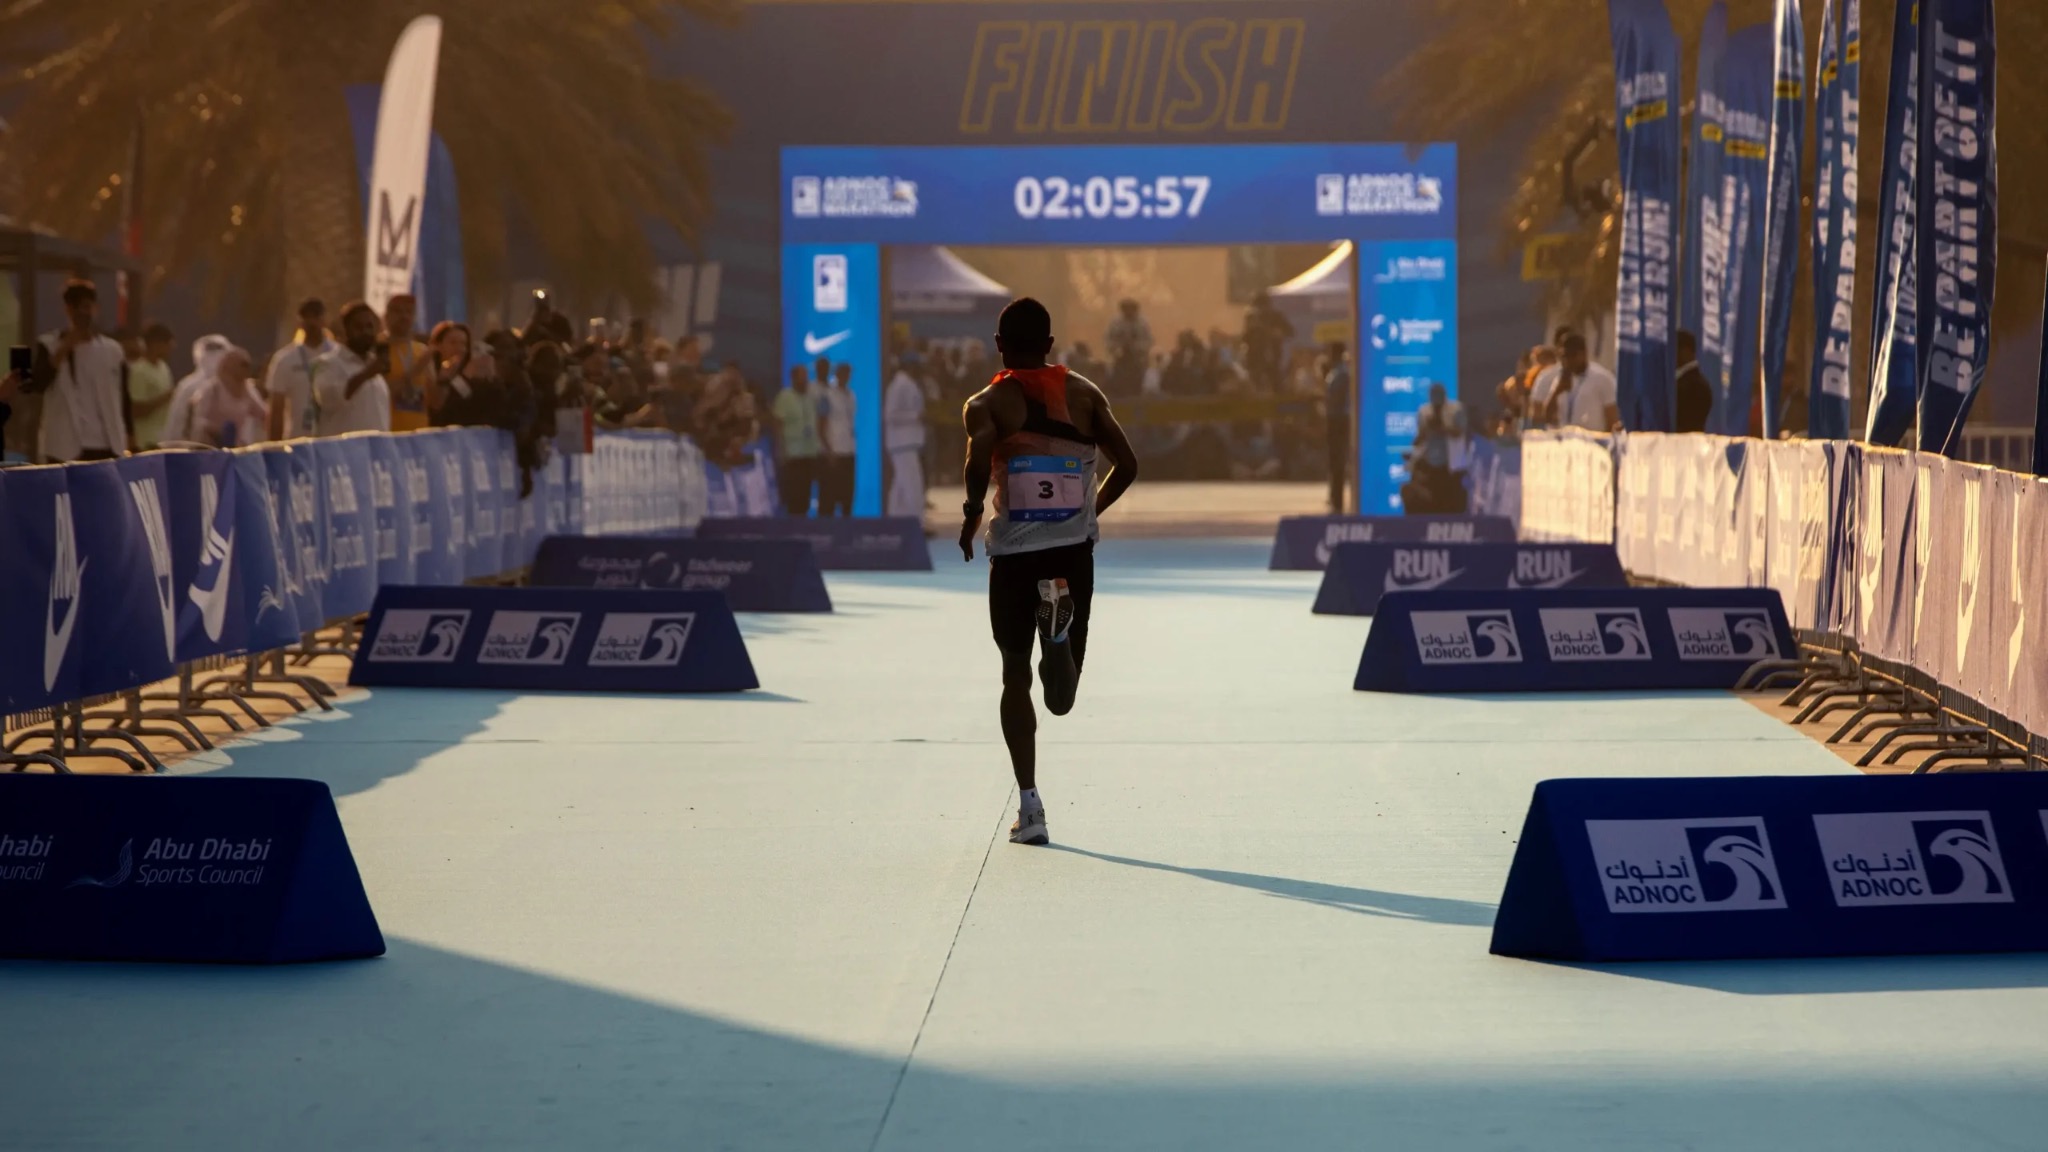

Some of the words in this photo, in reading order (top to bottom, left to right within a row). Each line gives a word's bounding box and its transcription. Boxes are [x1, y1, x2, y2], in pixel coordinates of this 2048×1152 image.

[1935, 20, 1976, 82] IT
[959, 18, 1305, 134] FINISH
[1934, 83, 1979, 160] OF
[1013, 176, 1211, 218] 02:05:57
[1643, 197, 1670, 287] RUN!
[1934, 161, 1978, 318] PART
[1643, 288, 1668, 343] WE
[1822, 337, 1850, 399] BE
[1930, 315, 1975, 395] BE
[1037, 480, 1054, 499] 3
[1394, 549, 1449, 580] RUN
[1516, 549, 1571, 580] RUN
[682, 573, 731, 588] group
[1424, 647, 1472, 660] ADNOC
[1553, 646, 1600, 657] ADNOC
[1682, 645, 1730, 656] ADNOC
[143, 837, 195, 860] Abu
[199, 837, 272, 861] Dhabi
[1833, 848, 1919, 875] أدنوك
[136, 864, 196, 887] Sports
[198, 865, 265, 885] Council
[1605, 854, 1690, 881] أدنوك
[1613, 884, 1697, 904] ADNOC
[1841, 877, 1924, 898] ADNOC
